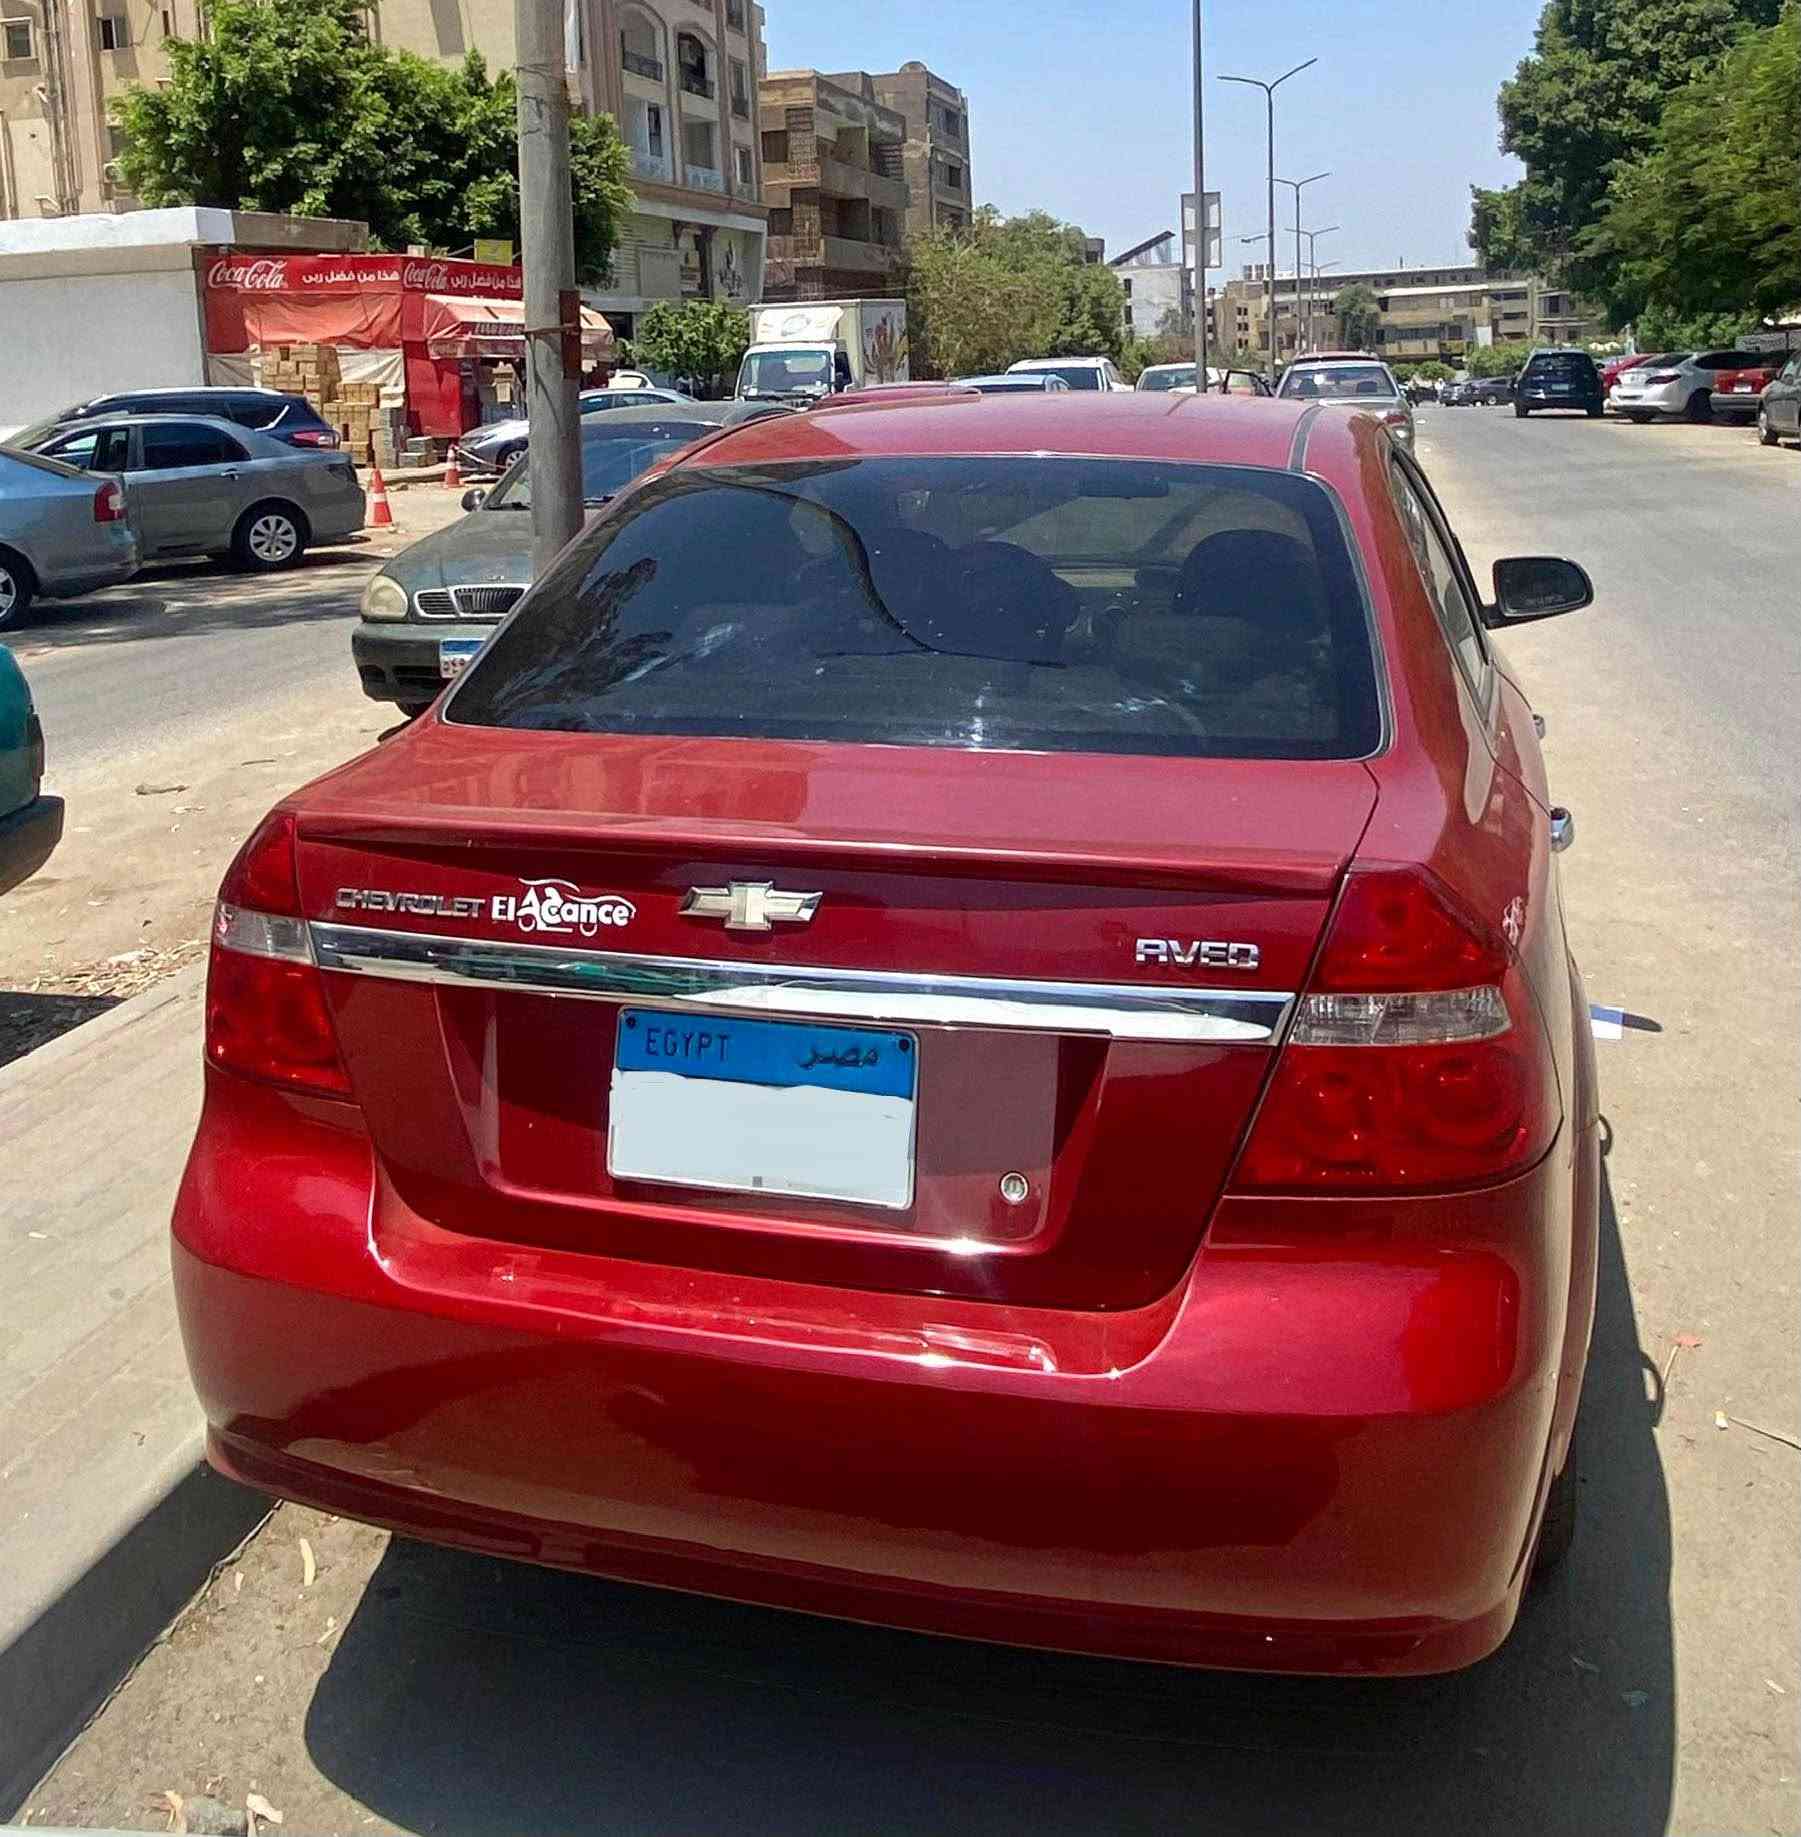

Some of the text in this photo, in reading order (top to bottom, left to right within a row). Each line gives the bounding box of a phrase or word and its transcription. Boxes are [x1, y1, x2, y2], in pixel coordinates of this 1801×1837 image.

[325, 269, 356, 283] فضل
[357, 270, 376, 283] من
[336, 887, 486, 917] CHEVROLET
[1135, 938, 1259, 968] AVEO
[645, 1028, 732, 1061] EGYPT
[799, 1045, 881, 1071] مصر
